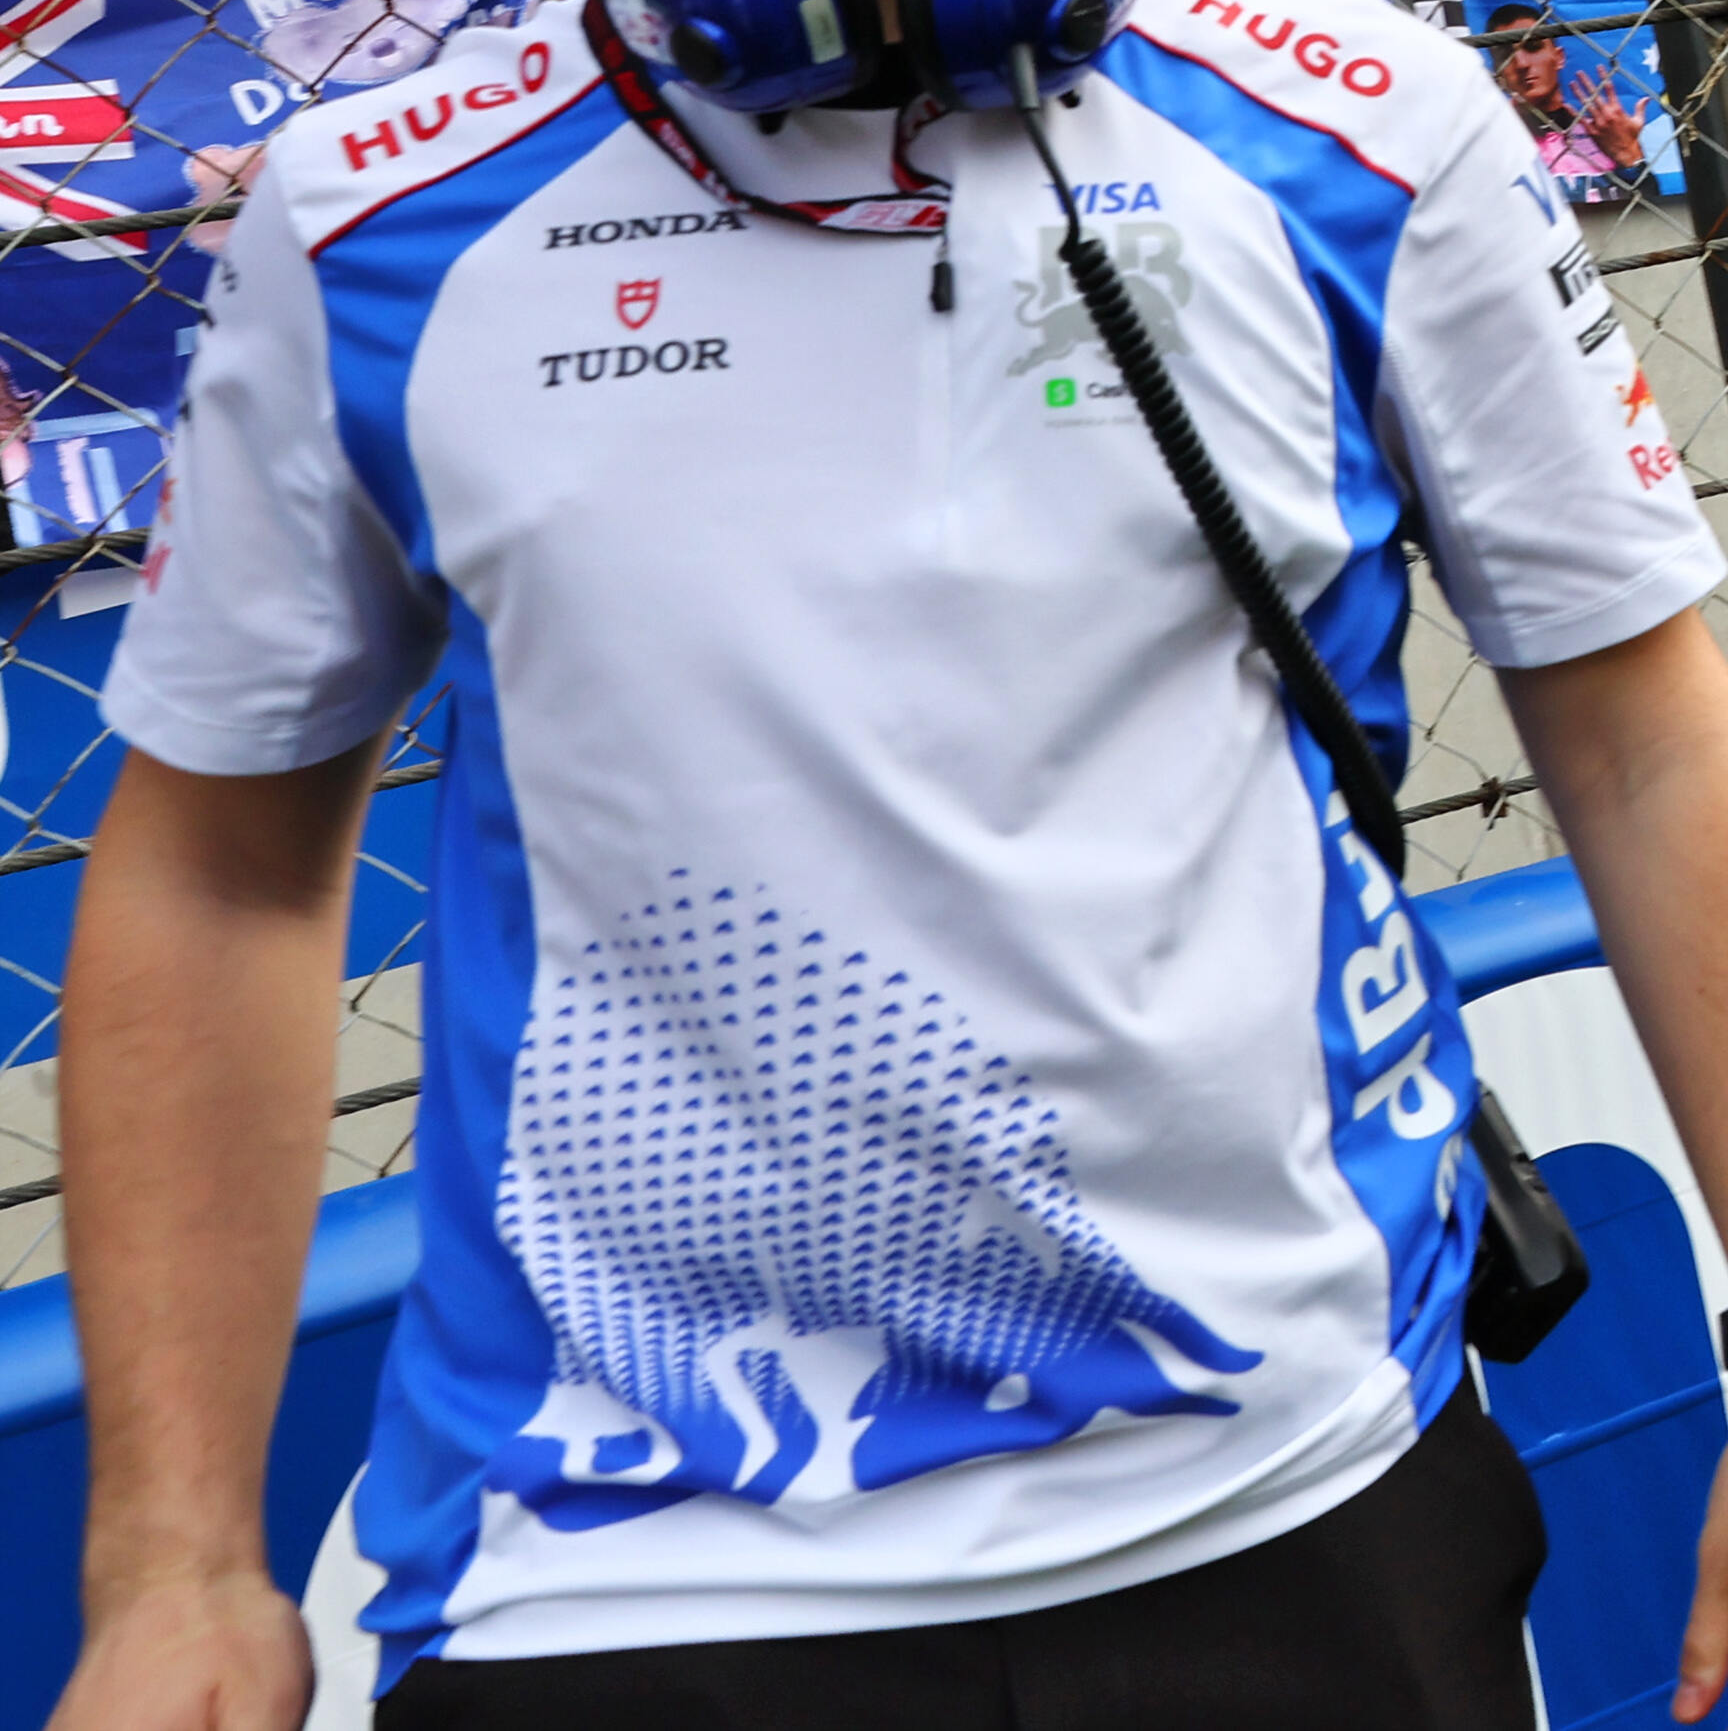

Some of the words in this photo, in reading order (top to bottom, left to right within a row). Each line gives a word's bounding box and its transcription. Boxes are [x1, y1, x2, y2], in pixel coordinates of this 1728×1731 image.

[341, 41, 551, 172] HUGO
[1042, 181, 1161, 214] VISA
[544, 209, 750, 250] HONDA
[539, 336, 731, 389] TUDOR
